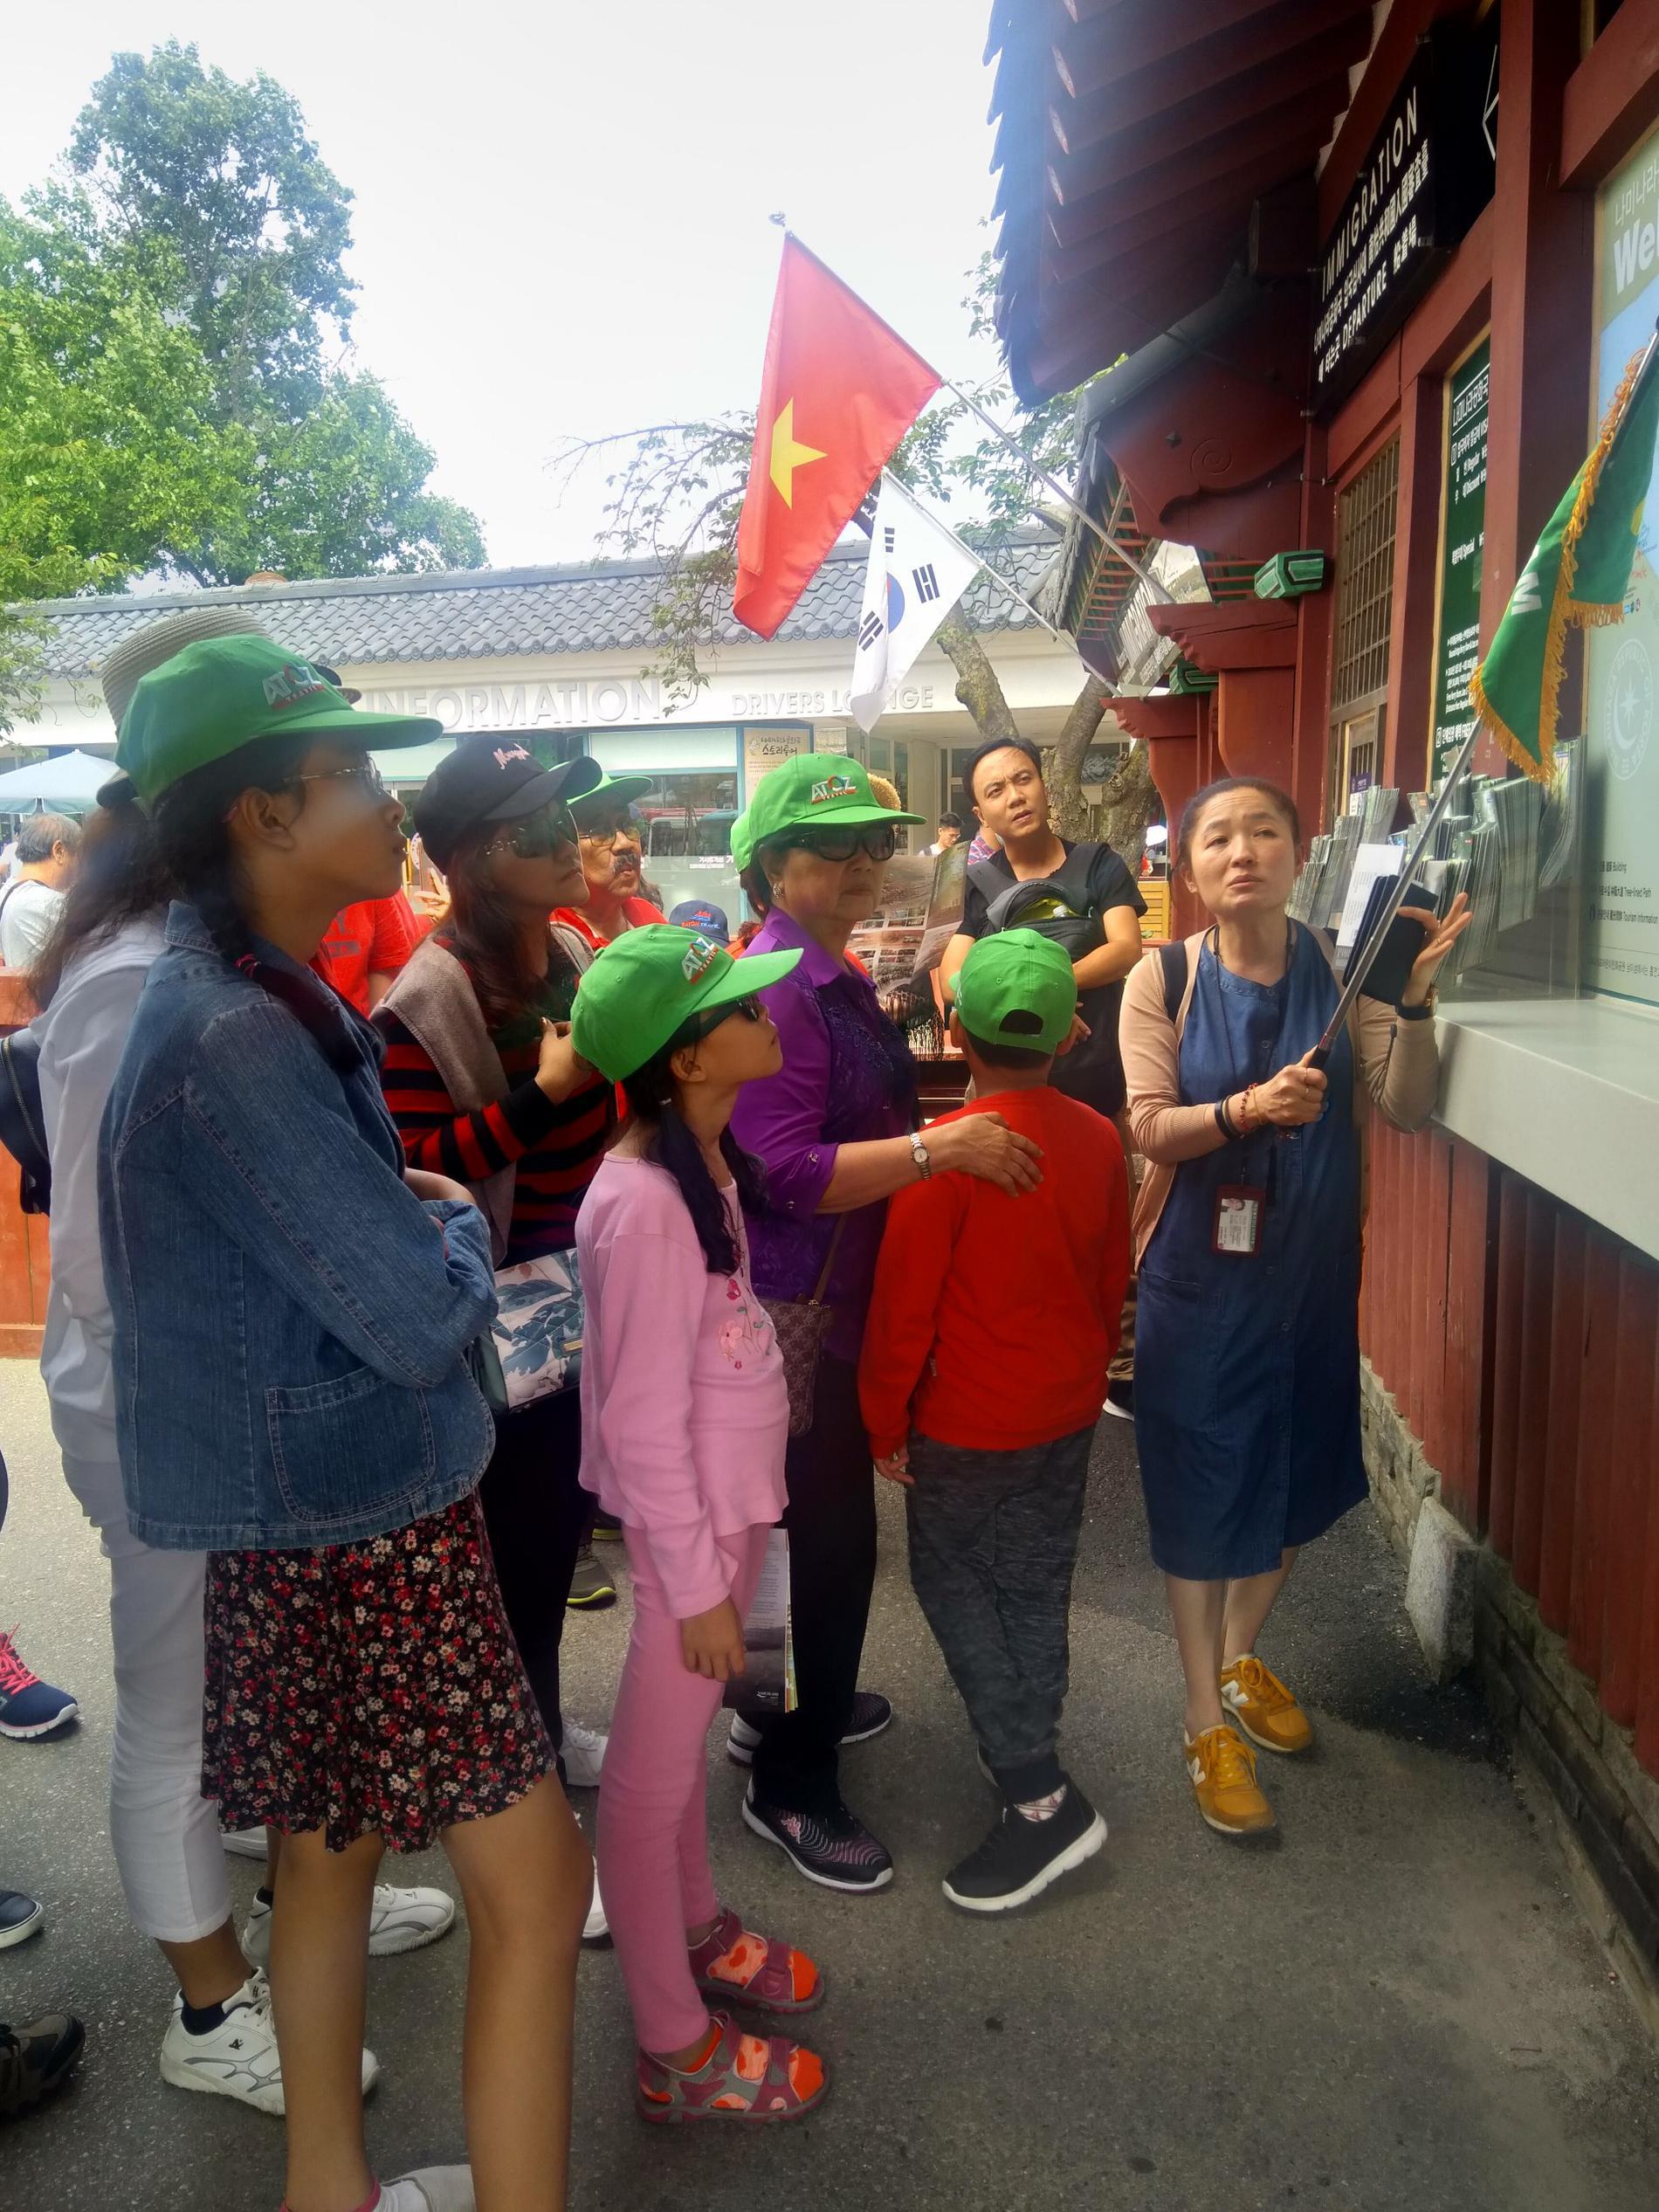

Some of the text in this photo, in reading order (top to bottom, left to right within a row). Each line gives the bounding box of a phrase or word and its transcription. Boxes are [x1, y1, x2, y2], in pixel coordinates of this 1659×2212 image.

[1322, 86, 1417, 303] IMMIGRATION
[1342, 260, 1387, 351] DEPARTURE
[367, 678, 661, 731] INFORMATION
[732, 690, 825, 716] DRIVERS
